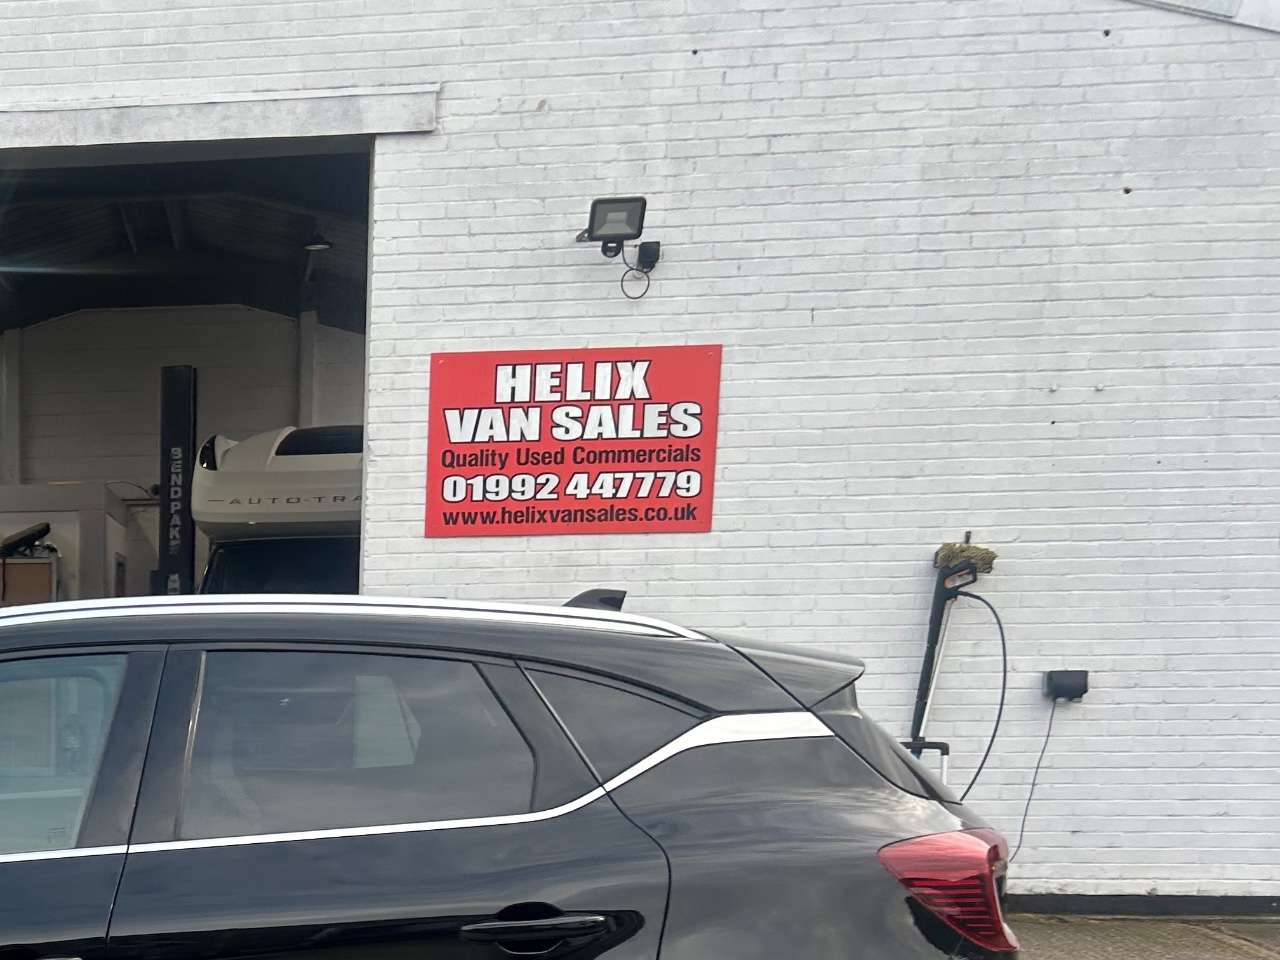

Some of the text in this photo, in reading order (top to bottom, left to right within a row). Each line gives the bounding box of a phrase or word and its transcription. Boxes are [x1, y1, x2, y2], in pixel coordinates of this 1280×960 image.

[494, 360, 652, 404] HELIX
[443, 401, 703, 444] VAN SALES
[441, 444, 701, 470] Quality Used Commercials
[229, 495, 362, 504] AUTO-TRA
[441, 470, 702, 502] 01992 447779
[443, 503, 697, 525] www.helixvansales.co.uk
